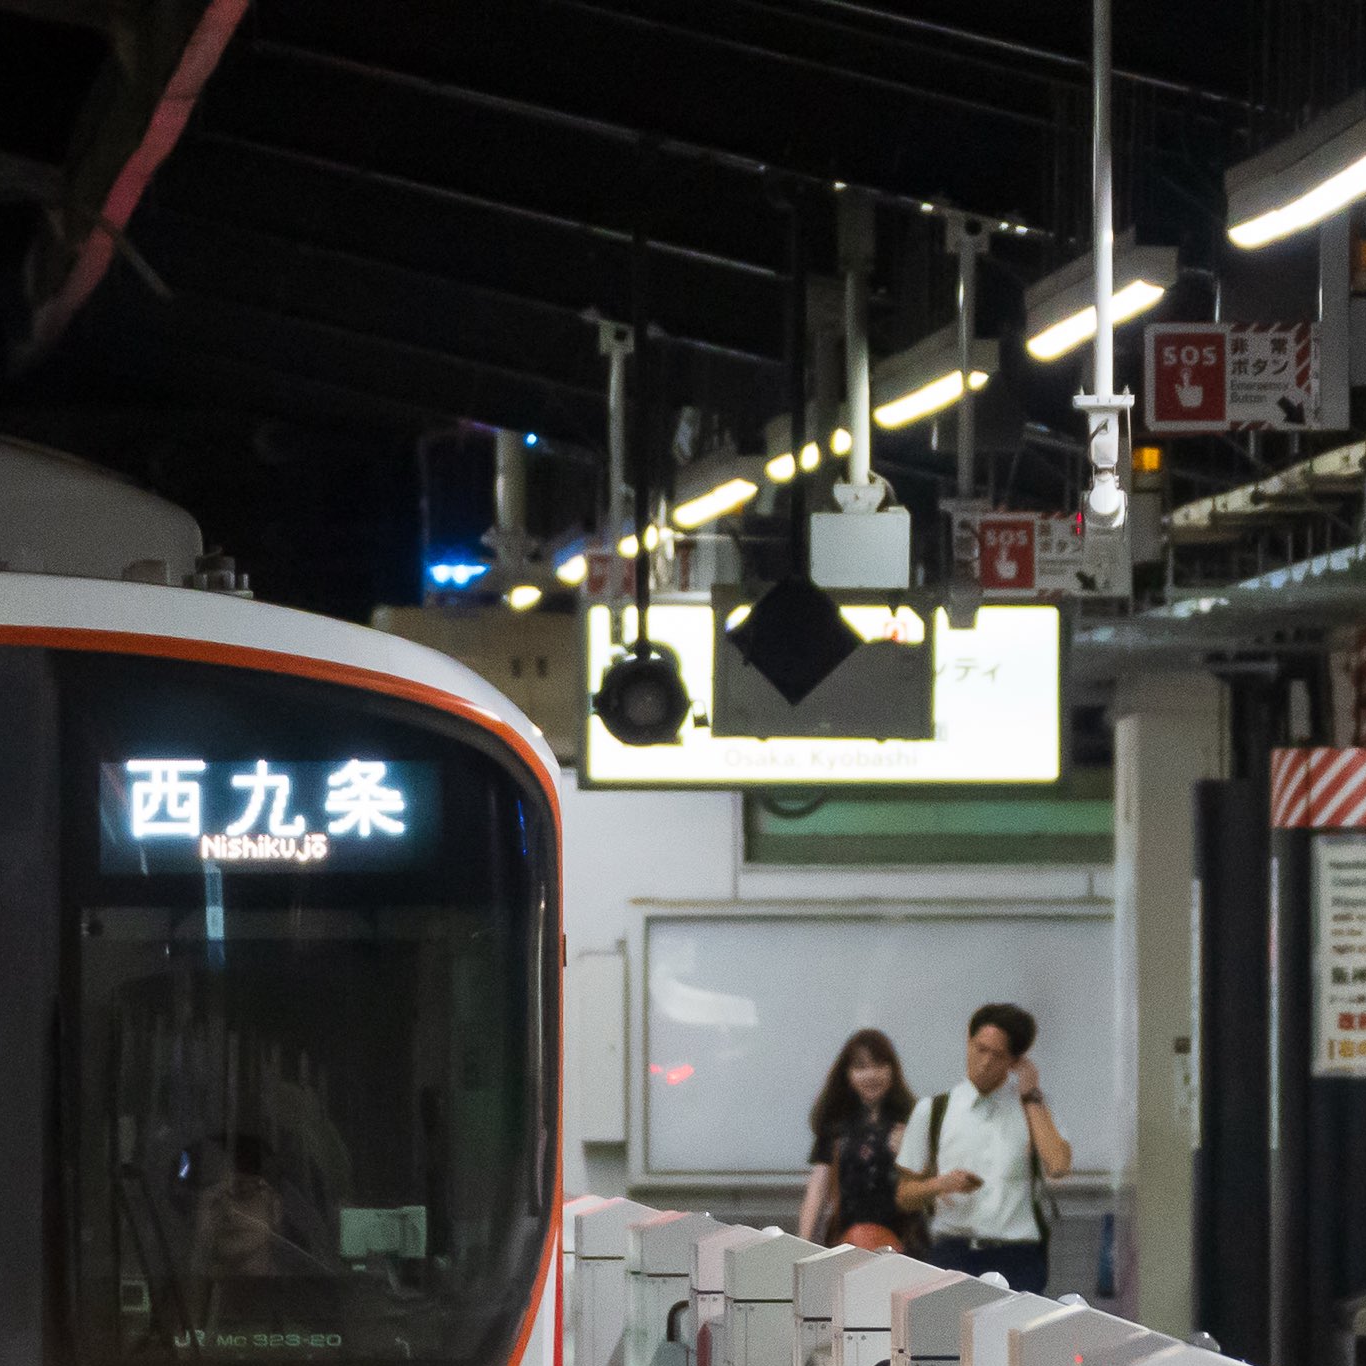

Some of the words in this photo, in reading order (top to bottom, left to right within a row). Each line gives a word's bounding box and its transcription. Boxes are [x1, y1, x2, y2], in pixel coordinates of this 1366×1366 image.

[1162, 345, 1217, 367] SOS
[125, 758, 408, 839] 西九条
